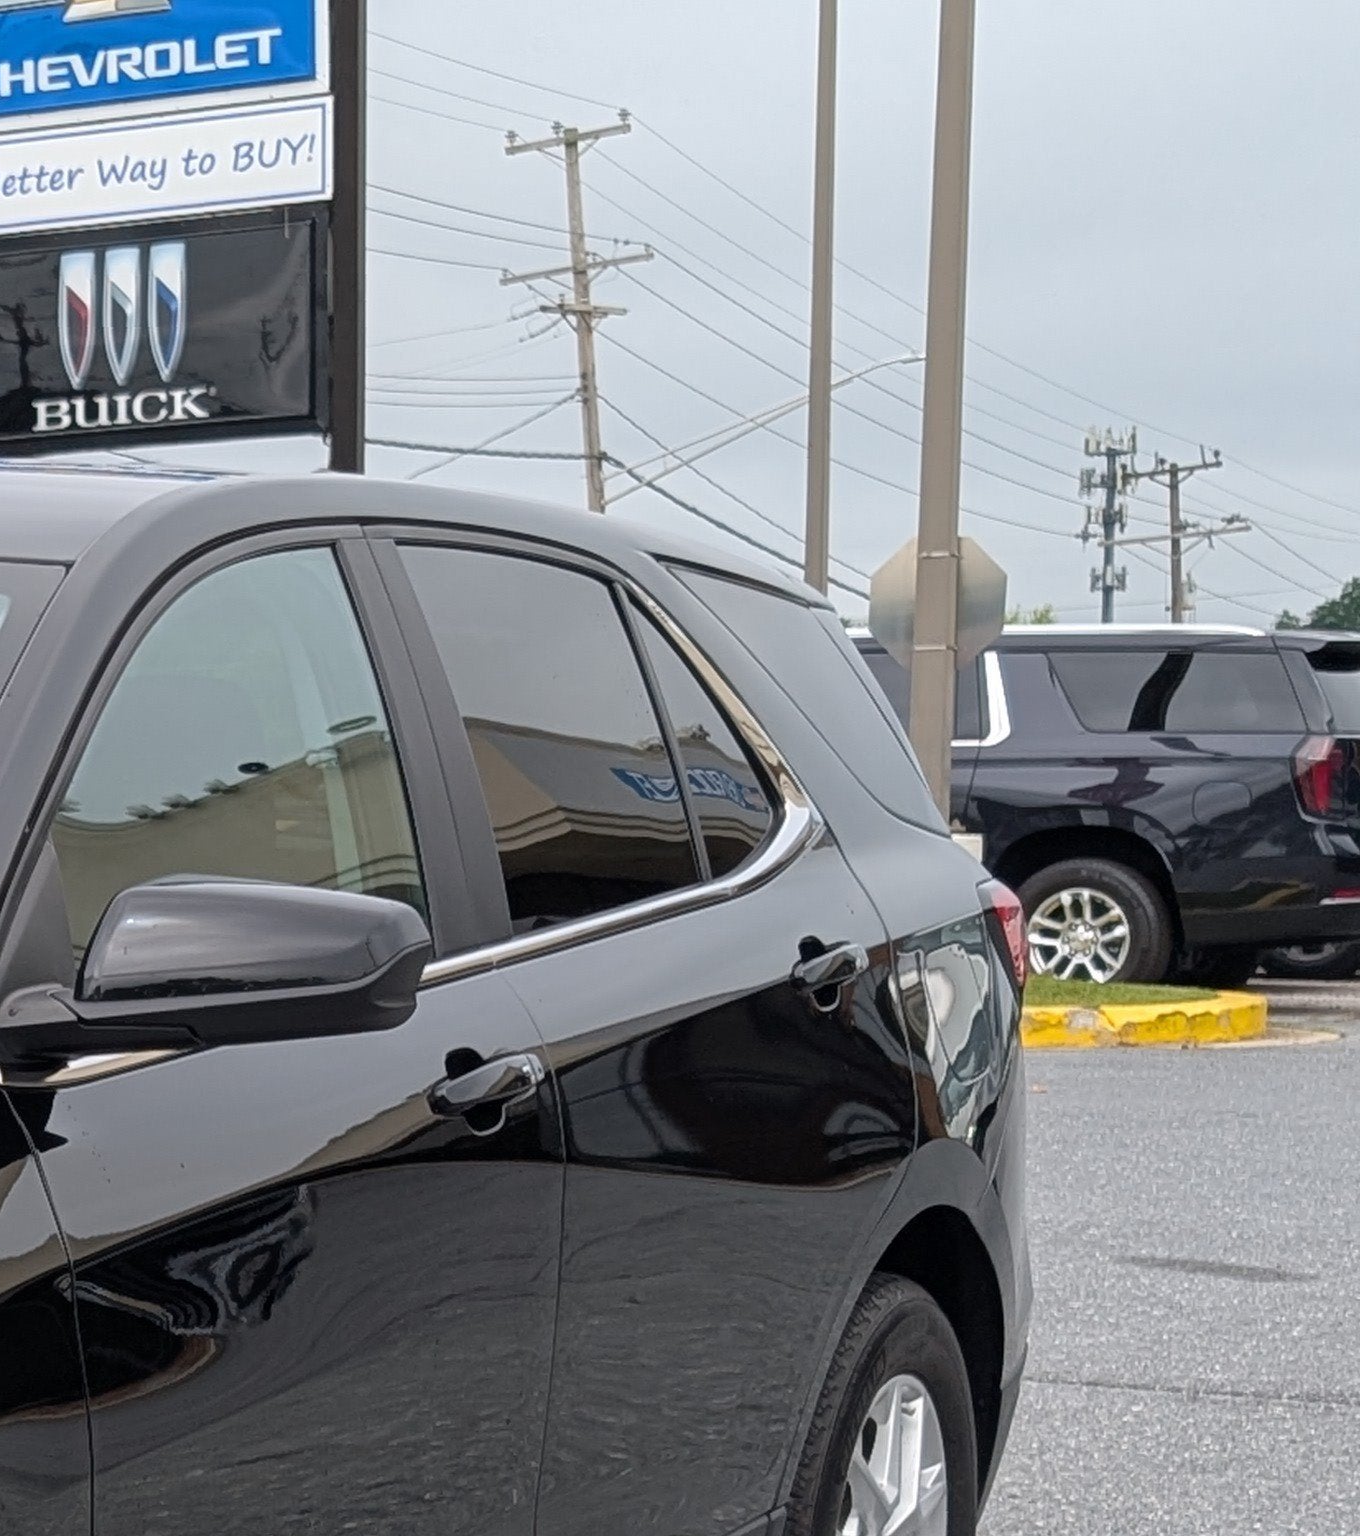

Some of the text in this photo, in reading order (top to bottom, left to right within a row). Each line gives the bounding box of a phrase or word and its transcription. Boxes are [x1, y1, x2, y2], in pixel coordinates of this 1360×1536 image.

[97, 156, 168, 191] Way
[183, 149, 216, 176] to
[231, 134, 317, 172] BUY!
[32, 389, 210, 433] BUICK
